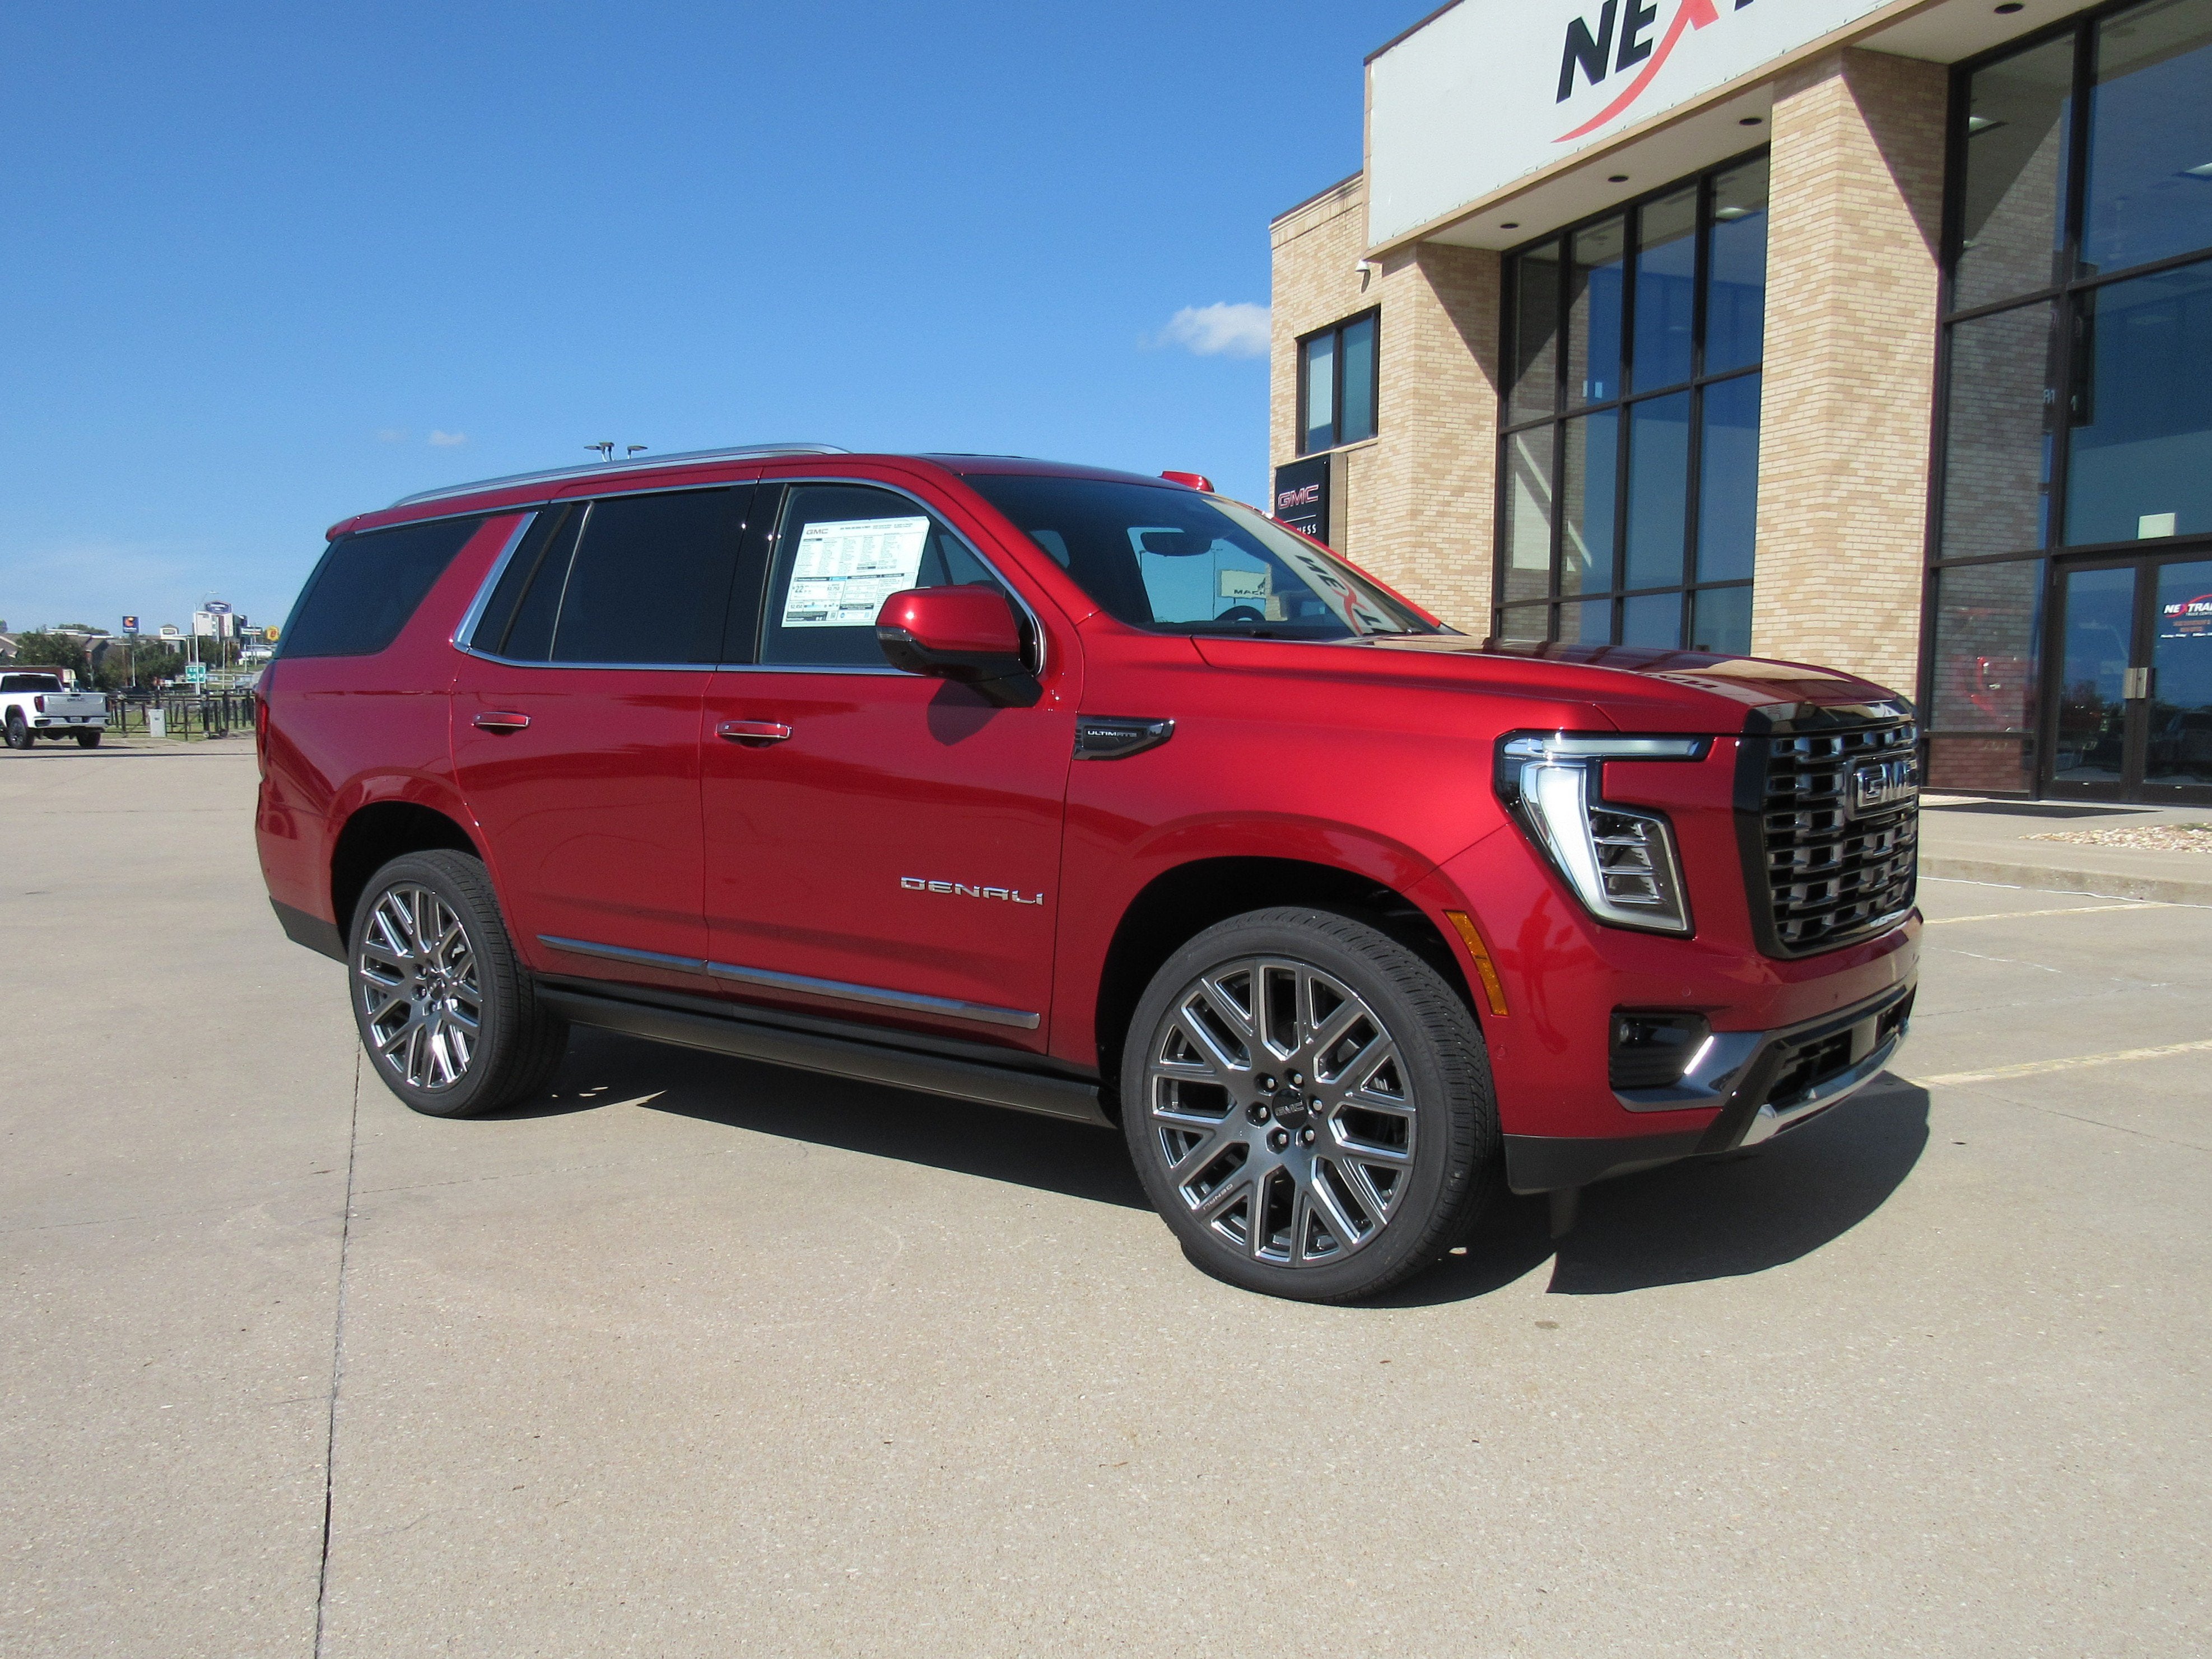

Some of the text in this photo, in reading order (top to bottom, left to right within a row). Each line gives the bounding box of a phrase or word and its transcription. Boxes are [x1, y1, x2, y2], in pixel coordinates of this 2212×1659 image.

[1278, 484, 1319, 509] GMC
[2163, 602, 2212, 614] NEXTRA
[1857, 759, 1918, 808] GMC
[901, 877, 1044, 906] DENALI
[1275, 1101, 1304, 1116] GMC
[1203, 1183, 1233, 1211] DENALI
